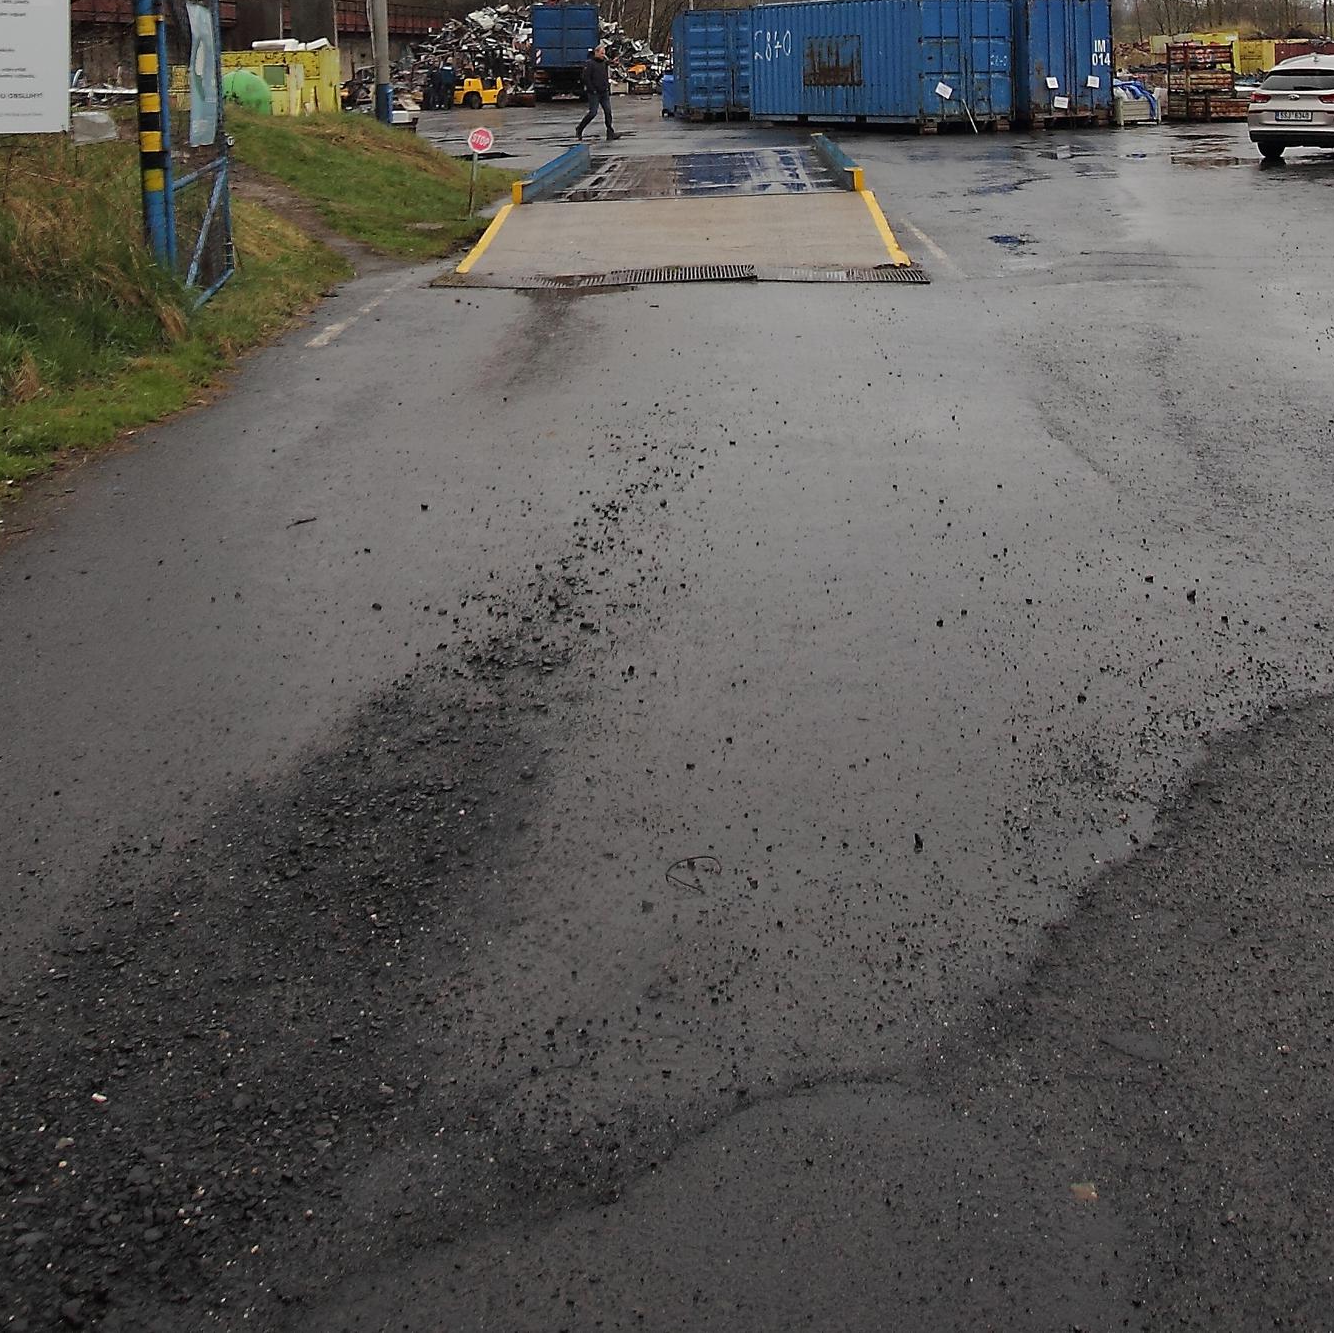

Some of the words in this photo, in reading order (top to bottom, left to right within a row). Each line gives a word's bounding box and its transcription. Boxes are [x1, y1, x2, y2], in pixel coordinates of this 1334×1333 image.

[1094, 39, 1106, 53] IM
[1091, 53, 1111, 66] 014
[471, 133, 490, 146] STOP
